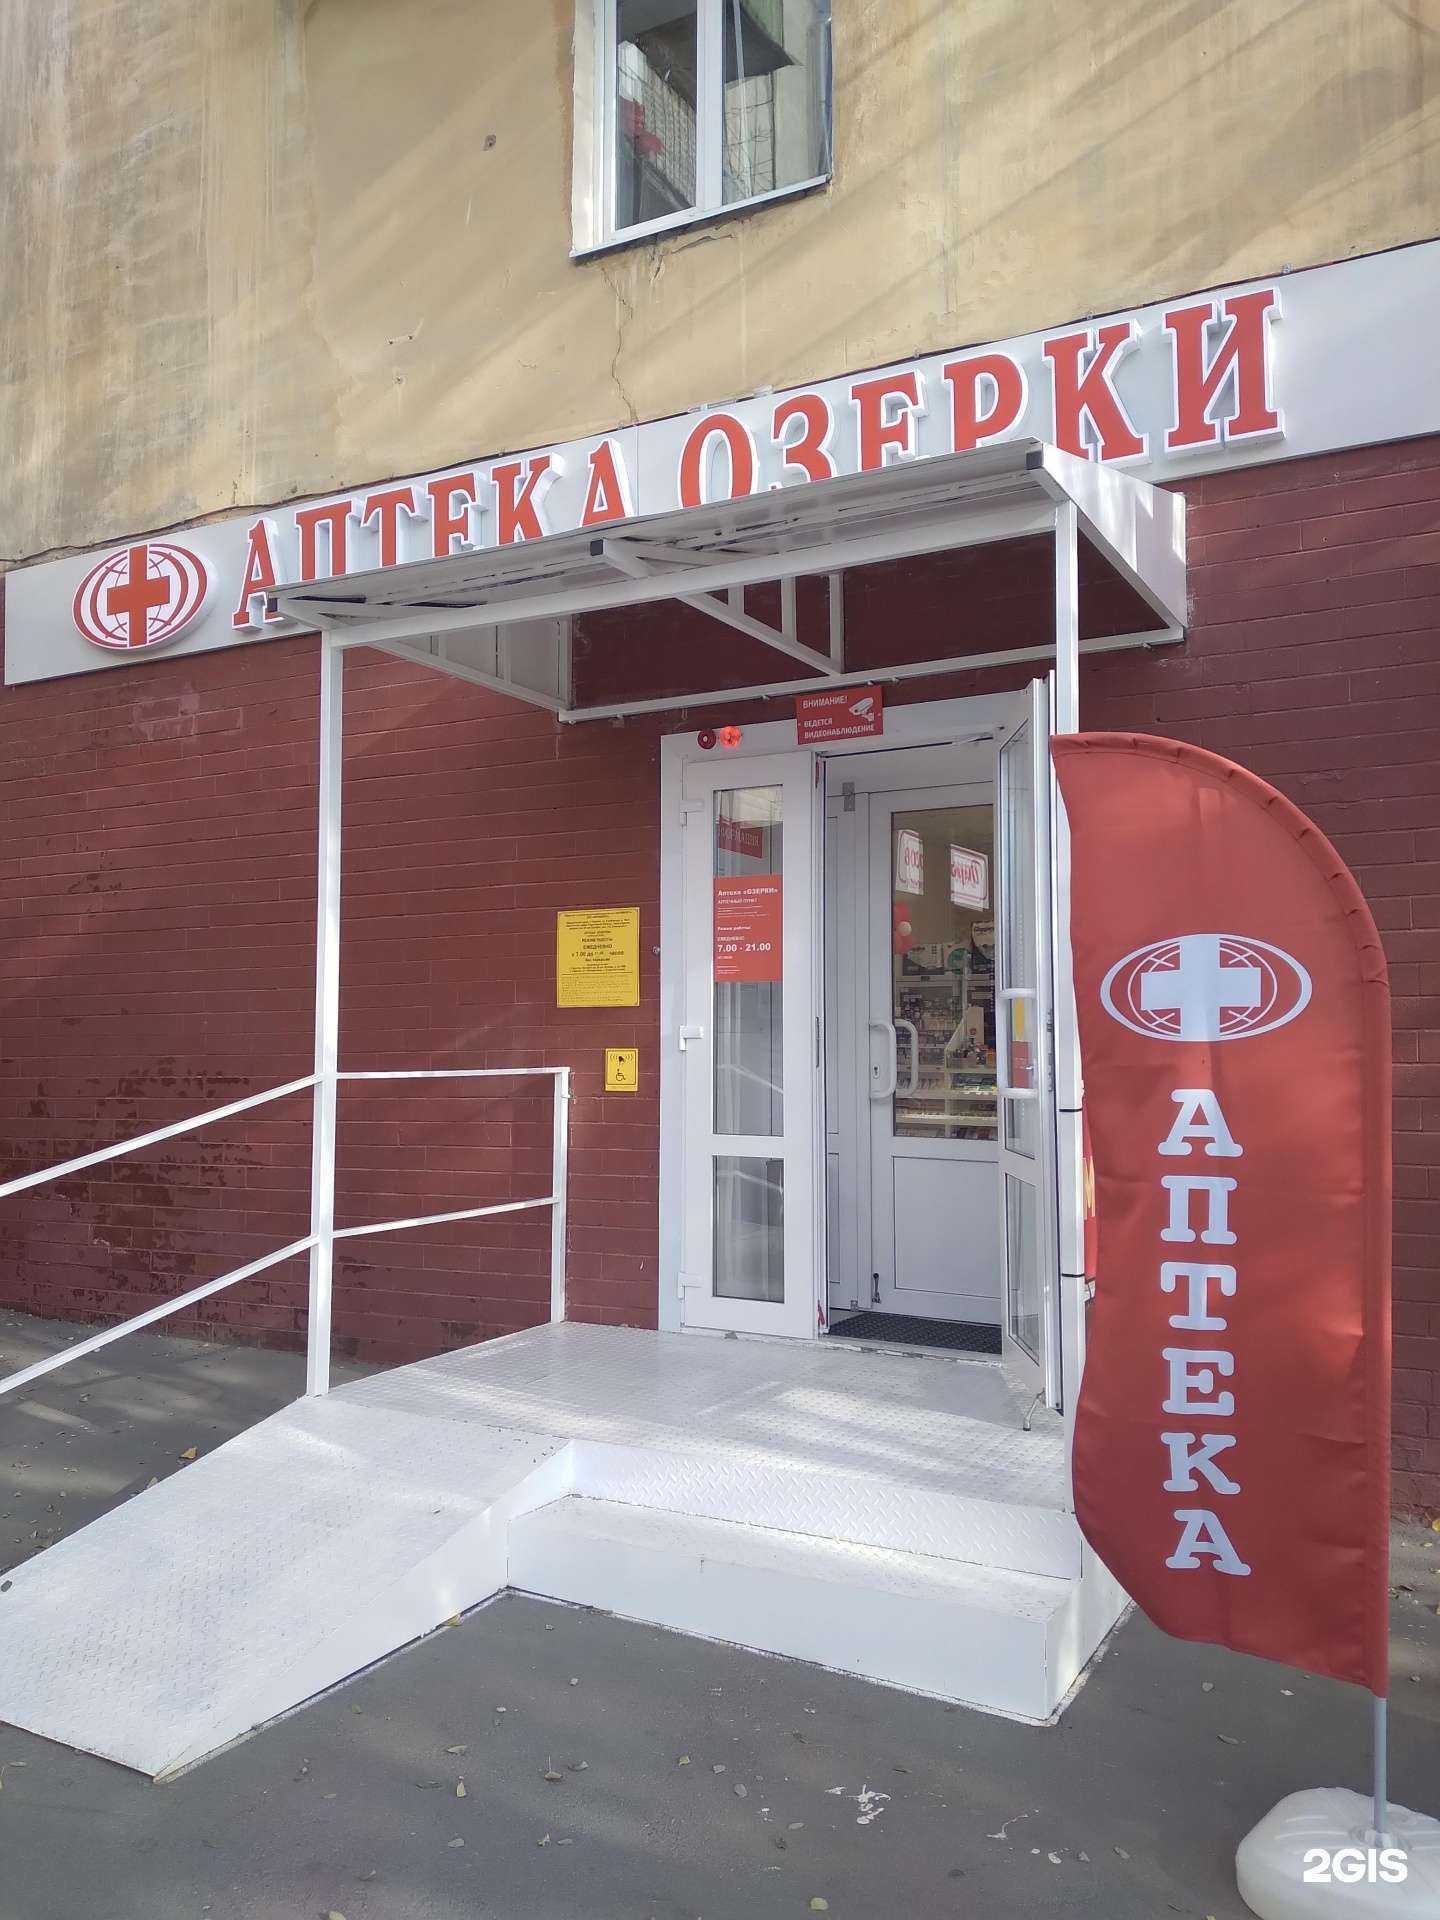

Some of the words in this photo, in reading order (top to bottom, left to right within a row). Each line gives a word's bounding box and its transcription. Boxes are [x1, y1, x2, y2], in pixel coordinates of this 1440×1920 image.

[231, 437, 630, 628] АПТЕКА
[678, 287, 1284, 510] ОЗЕРКИ
[802, 695, 848, 709] ВНИМАНИЕ!
[803, 717, 833, 729] ВЕДЕТСЯ
[804, 723, 875, 740] ВИДЕОНАБЛЮДЕНИЕ
[717, 943, 738, 953] 7.00
[745, 942, 772, 953] 21.00
[1157, 1088, 1252, 1576] АПТЕКА
